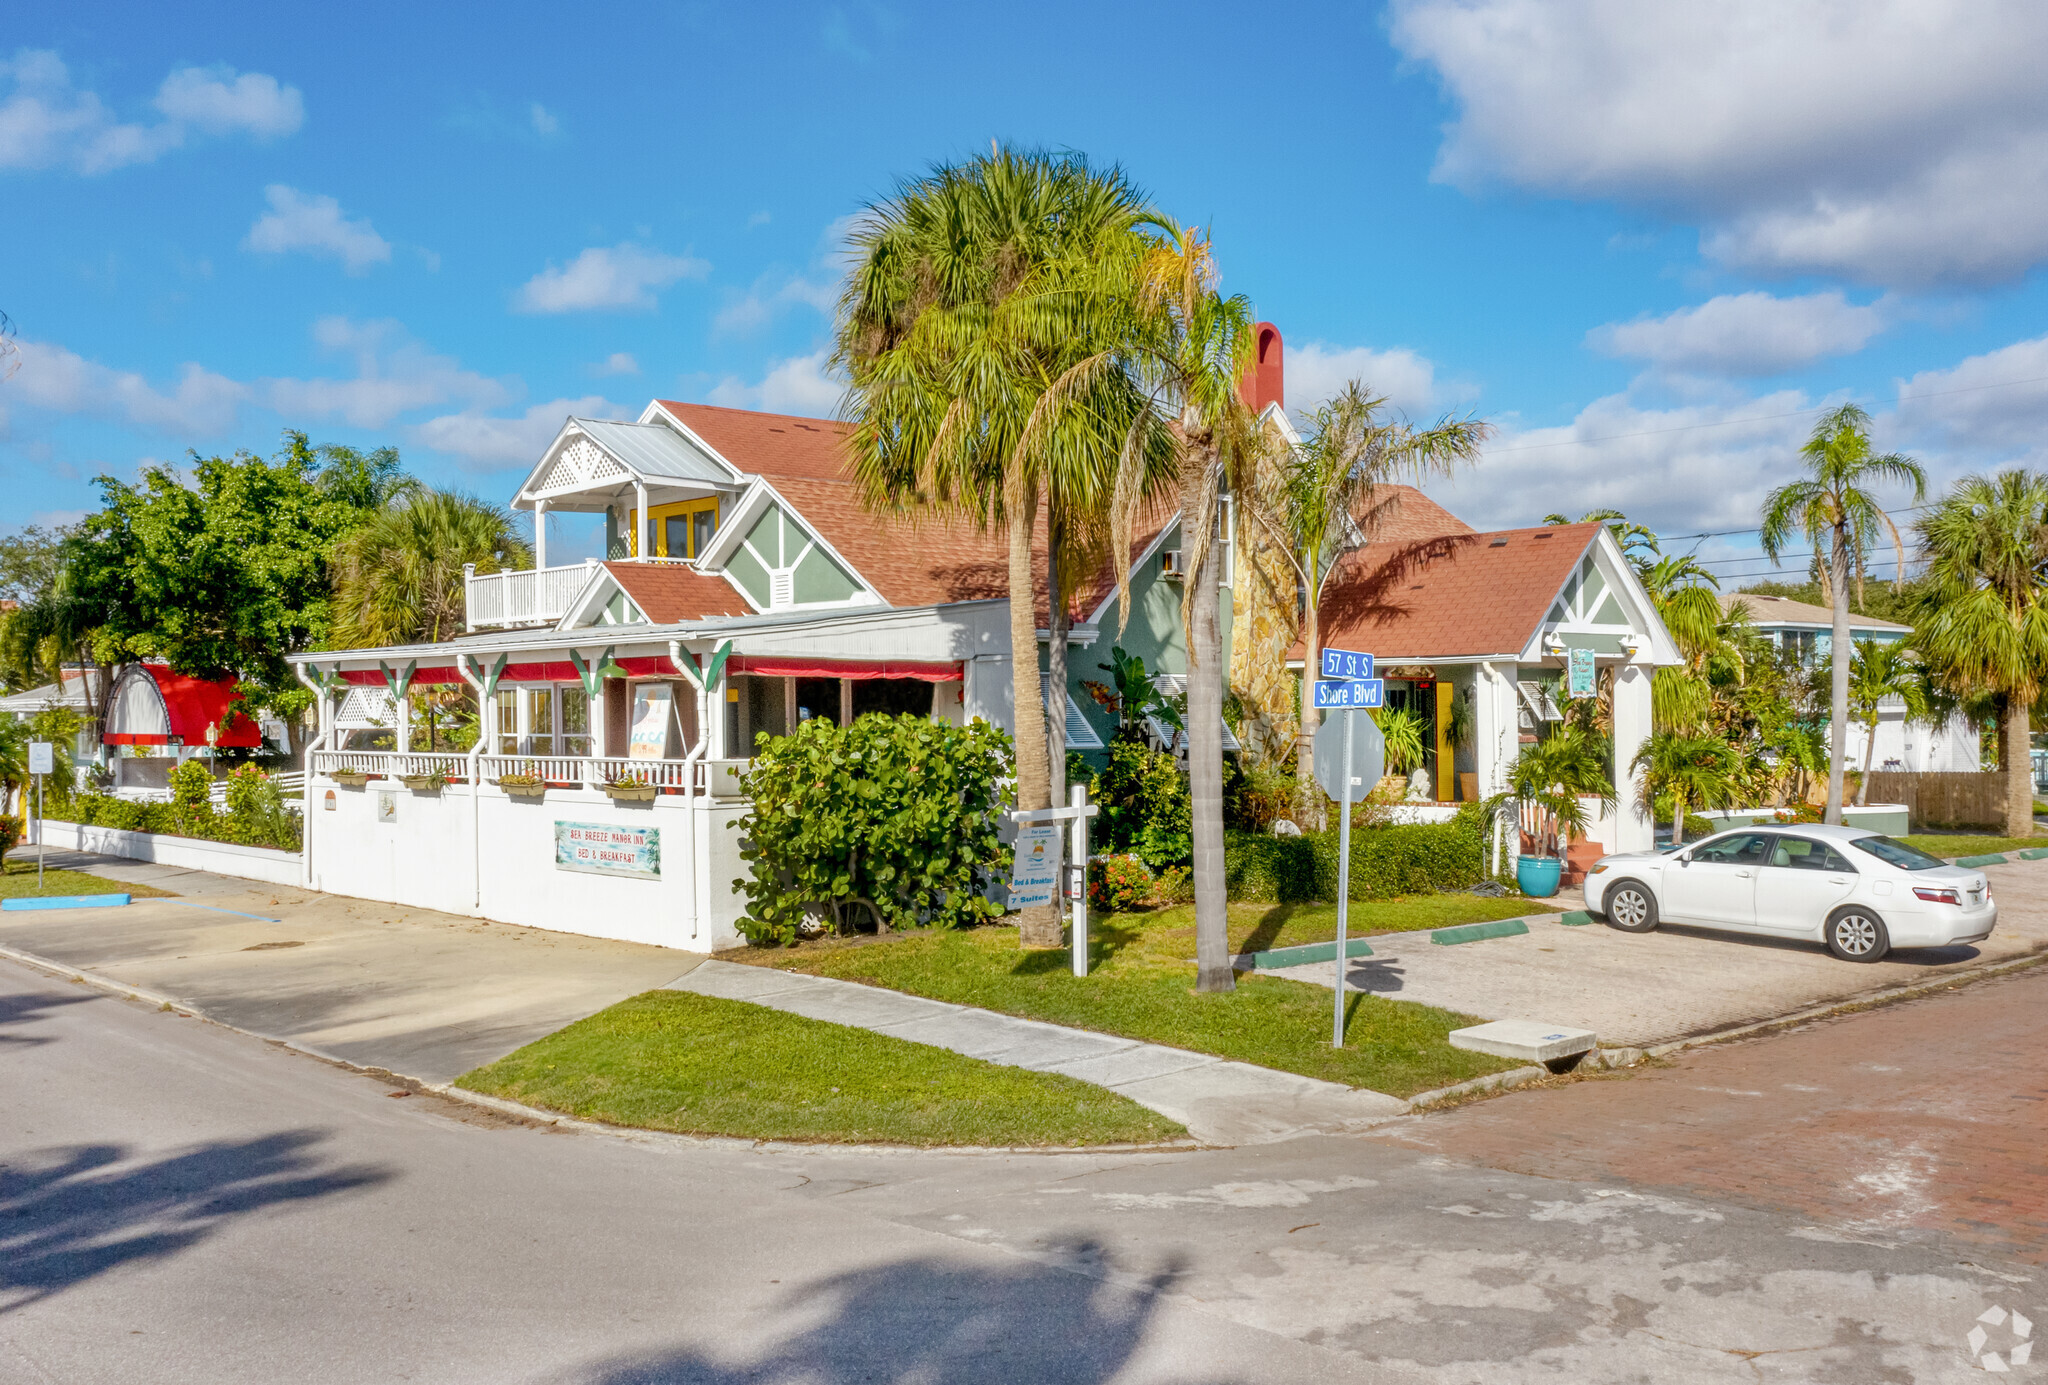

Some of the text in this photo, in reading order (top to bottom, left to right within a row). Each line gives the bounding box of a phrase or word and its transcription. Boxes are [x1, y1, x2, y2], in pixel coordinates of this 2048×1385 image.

[1328, 653, 1368, 677] 57 St S
[1320, 683, 1377, 704] Shore Blvd
[570, 829, 644, 845] SEA BREEZE MANOR INN
[578, 848, 635, 863] BED & BREAKFAST
[1020, 895, 1049, 903] Suites
